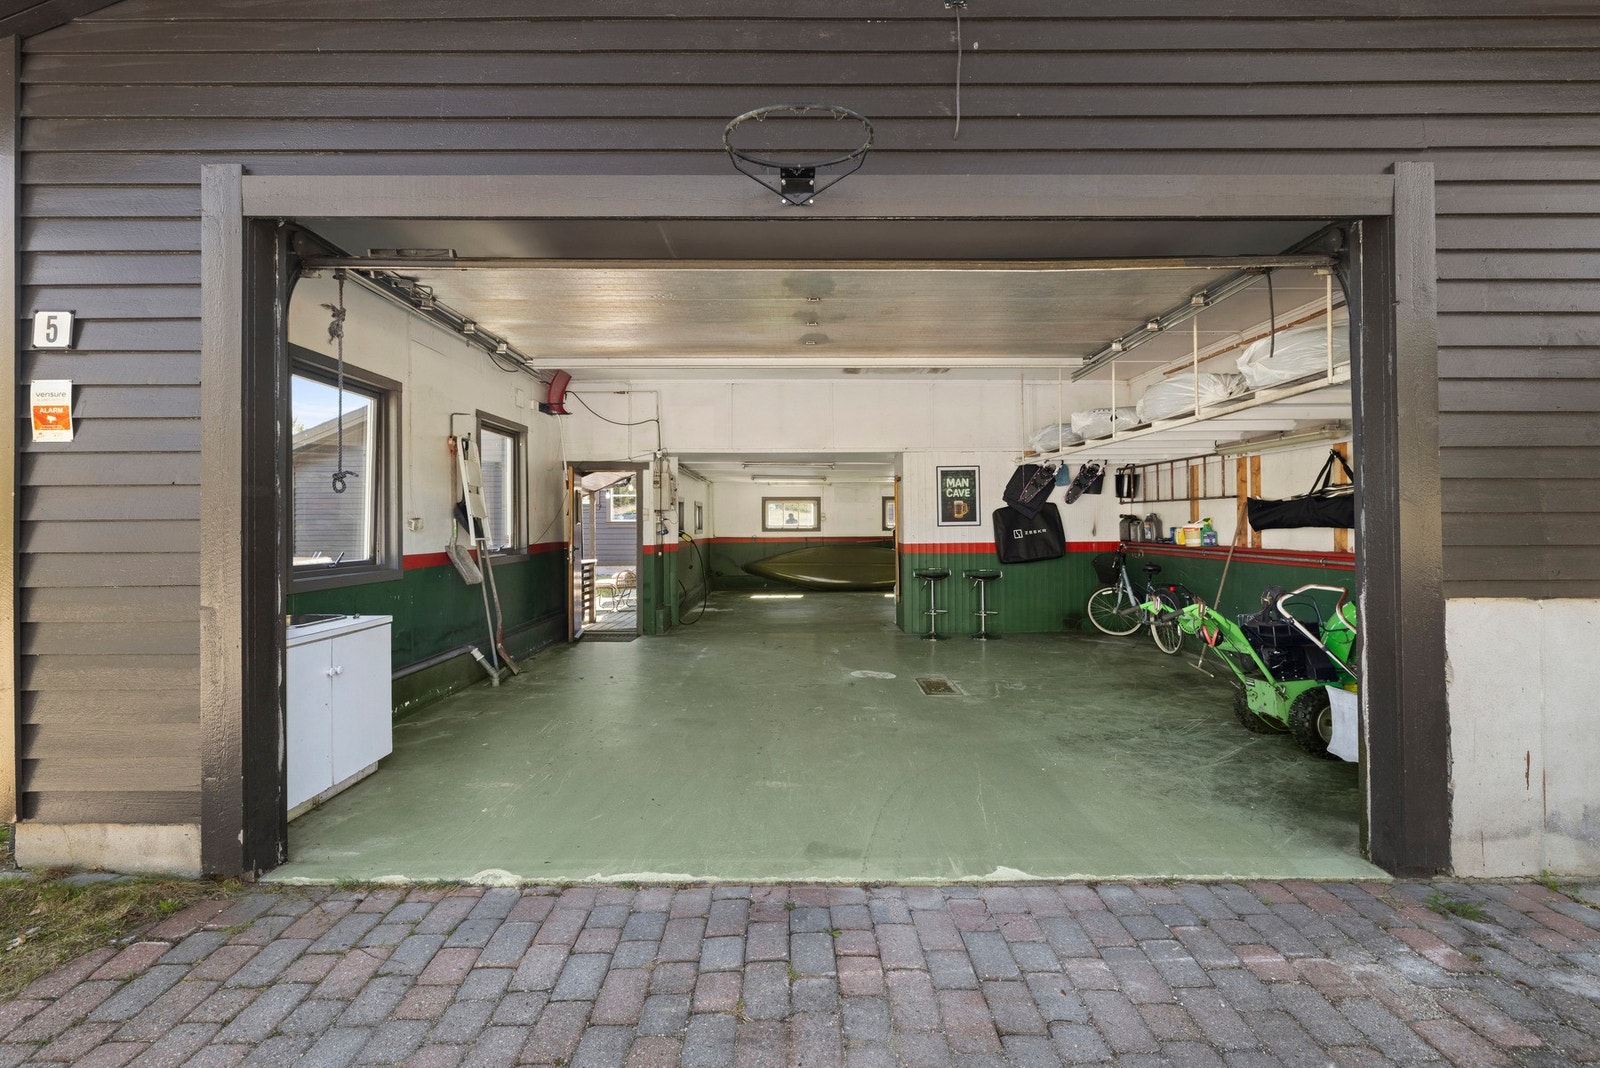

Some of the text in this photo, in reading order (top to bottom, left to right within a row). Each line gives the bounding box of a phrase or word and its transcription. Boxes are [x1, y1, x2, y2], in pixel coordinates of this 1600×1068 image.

[45, 315, 58, 343] 5
[946, 478, 969, 488] MAN
[946, 488, 970, 497] CAVE
